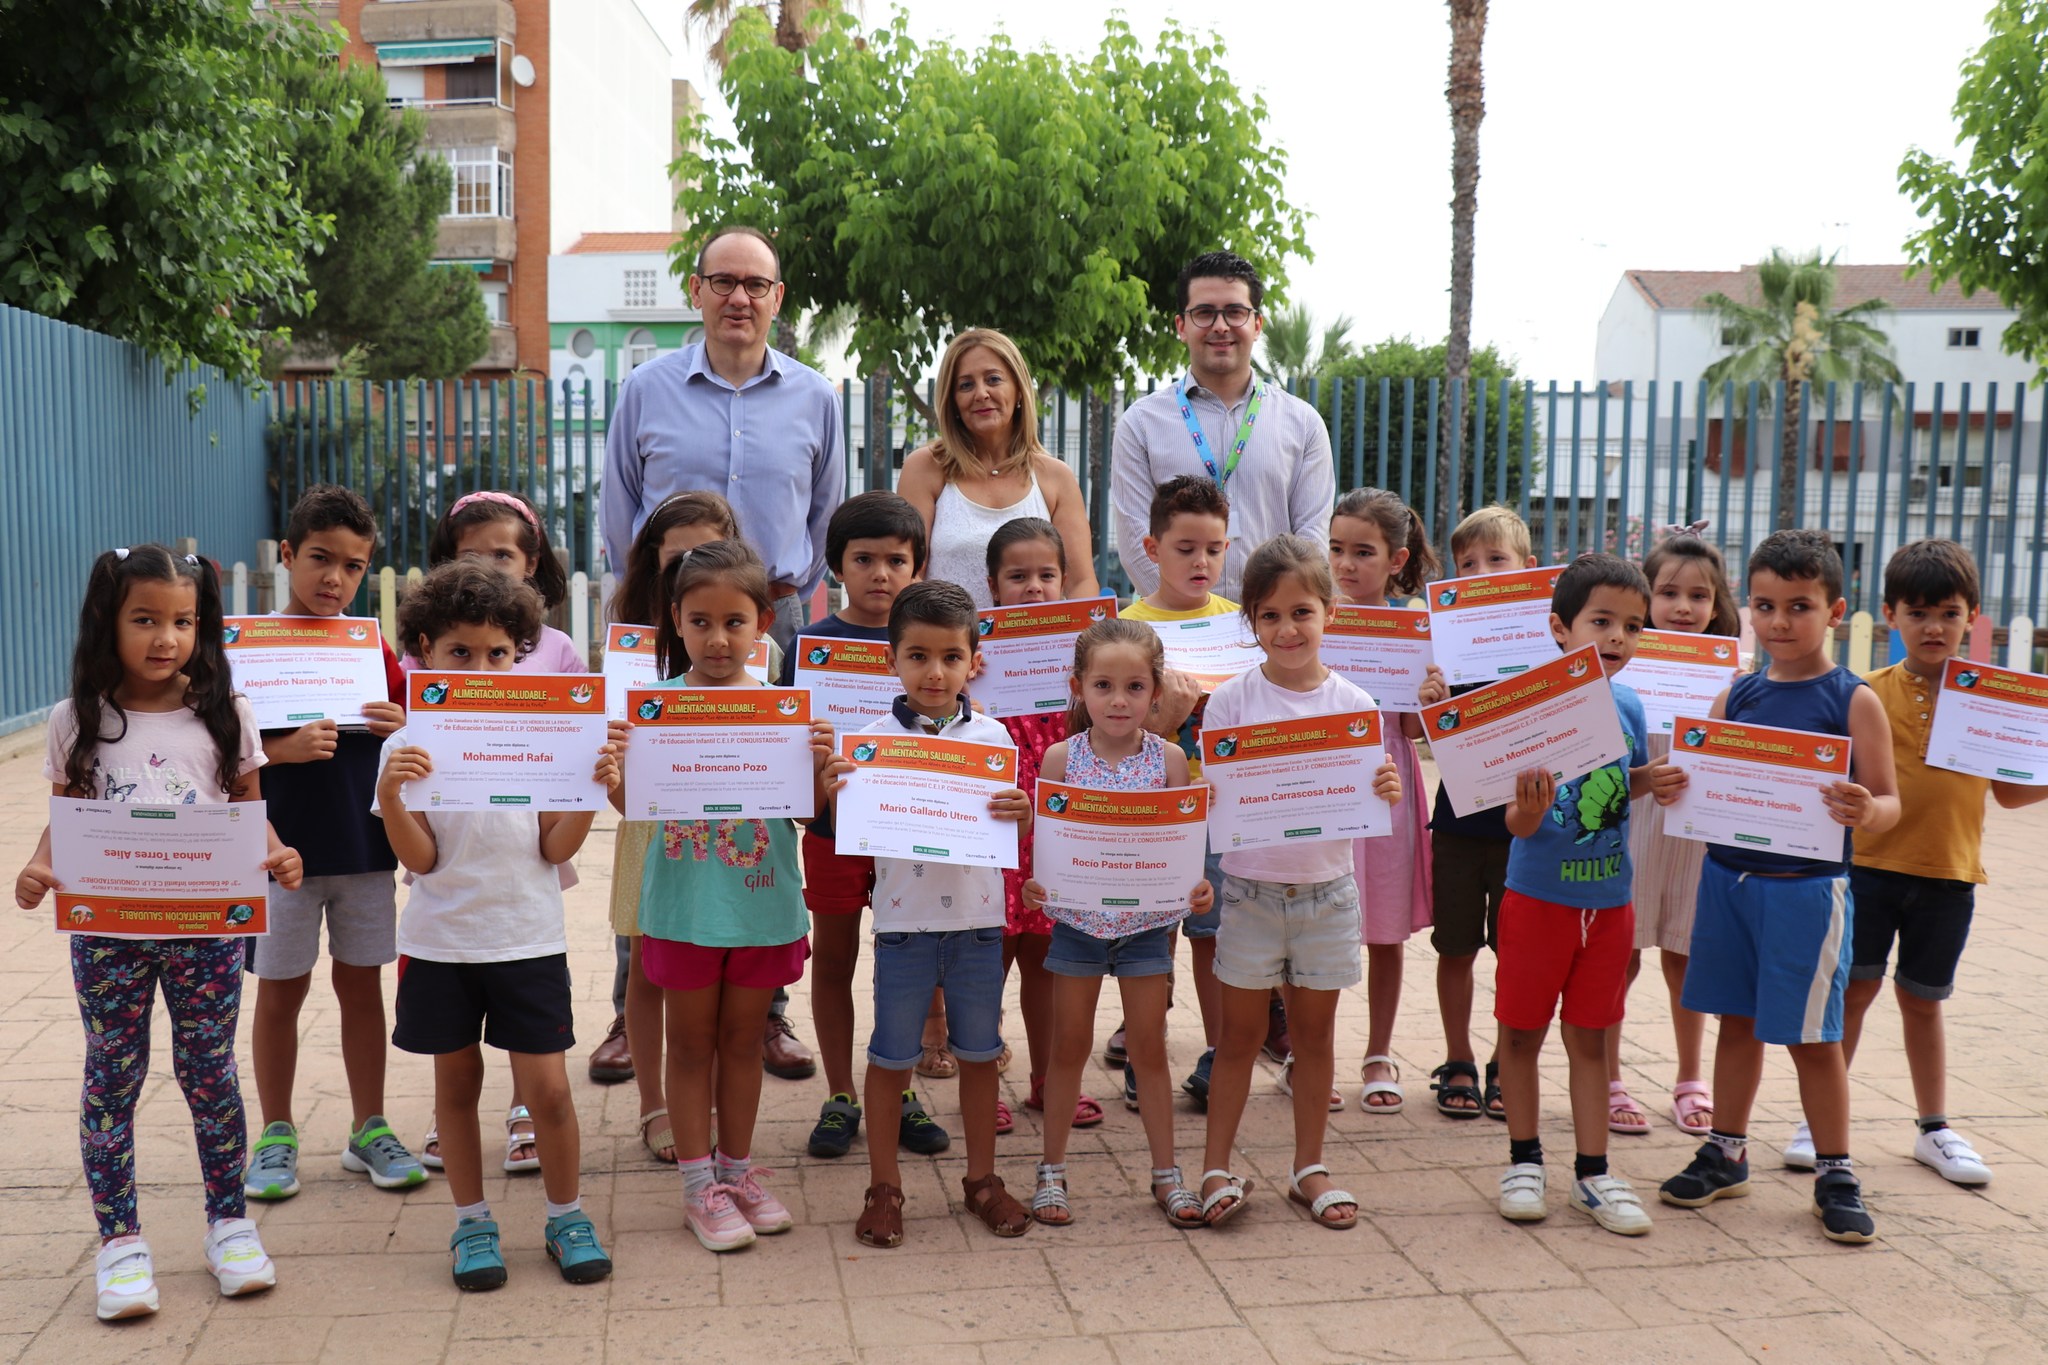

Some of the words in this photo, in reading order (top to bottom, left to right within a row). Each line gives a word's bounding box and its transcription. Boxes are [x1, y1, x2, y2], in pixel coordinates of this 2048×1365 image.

[1501, 582, 1532, 592] SALUDABLE
[1039, 615, 1071, 624] SALUDABLE
[245, 628, 291, 638] ALIMENTACIÓN
[292, 629, 328, 638] SALUDABLE
[1472, 636, 1500, 645] Alberto
[833, 653, 876, 664] ALIMENTACIÓN
[1005, 668, 1027, 678] María
[1030, 666, 1059, 675] Horrillo
[1351, 664, 1376, 673] Blanes
[1379, 667, 1409, 675] Delgado
[244, 678, 288, 689] Alejandro
[292, 678, 327, 687] Naranjo
[330, 677, 354, 686] Tapia
[453, 689, 504, 699] ALIMENTACIÓN
[507, 690, 547, 700] SALUDABLE
[1464, 695, 1512, 719] ALIMENTACIÓN
[1512, 680, 1548, 700] SALUDABLE
[667, 702, 715, 714] ALIMENTACIÓN
[718, 704, 755, 713] SALUDABLE
[828, 704, 857, 714] Miguel
[1967, 726, 1992, 738] Pablo
[1241, 733, 1288, 749] ALIMENTACIÓN
[1290, 730, 1327, 742] SALUDABLE
[1484, 754, 1504, 768] Luis
[1506, 741, 1545, 761] Montero
[1547, 727, 1578, 745] Ramos
[1757, 742, 1793, 754] SALUDABLE
[463, 752, 524, 761] Mohammed
[527, 753, 553, 762] Rafai
[881, 748, 928, 759] ALIMENTACIÓN
[930, 752, 966, 764] SALUDABLE
[672, 764, 692, 772] Noa
[694, 764, 740, 772] Broncano
[743, 763, 768, 772] Pozo
[1244, 769, 1271, 778] Educación
[1272, 766, 1290, 774] Infantil
[1239, 794, 1269, 805] Aitana
[1272, 789, 1324, 801] Carrascosa
[1327, 785, 1355, 795] Acedo
[1706, 791, 1723, 801] Eric
[1726, 793, 1764, 807] Sánchez
[880, 803, 907, 813] Mario
[910, 806, 948, 818] Gallardo
[950, 811, 978, 822] Utrero
[1071, 801, 1117, 814] ALIMENTACIÓN
[1120, 805, 1158, 814] SALUDABLE
[1070, 833, 1096, 842] Educación
[104, 850, 131, 860] Alies
[134, 850, 170, 861] Torres
[173, 852, 212, 862] Ainhoa
[1072, 858, 1099, 868] Rocío
[1102, 861, 1132, 869] Pastor
[1136, 861, 1167, 869] Blanco
[1560, 852, 1624, 882] HULK!
[188, 879, 220, 887] Educación
[119, 910, 163, 921] SALUDABLE
[166, 911, 221, 923] ALIMENTACIÓN
